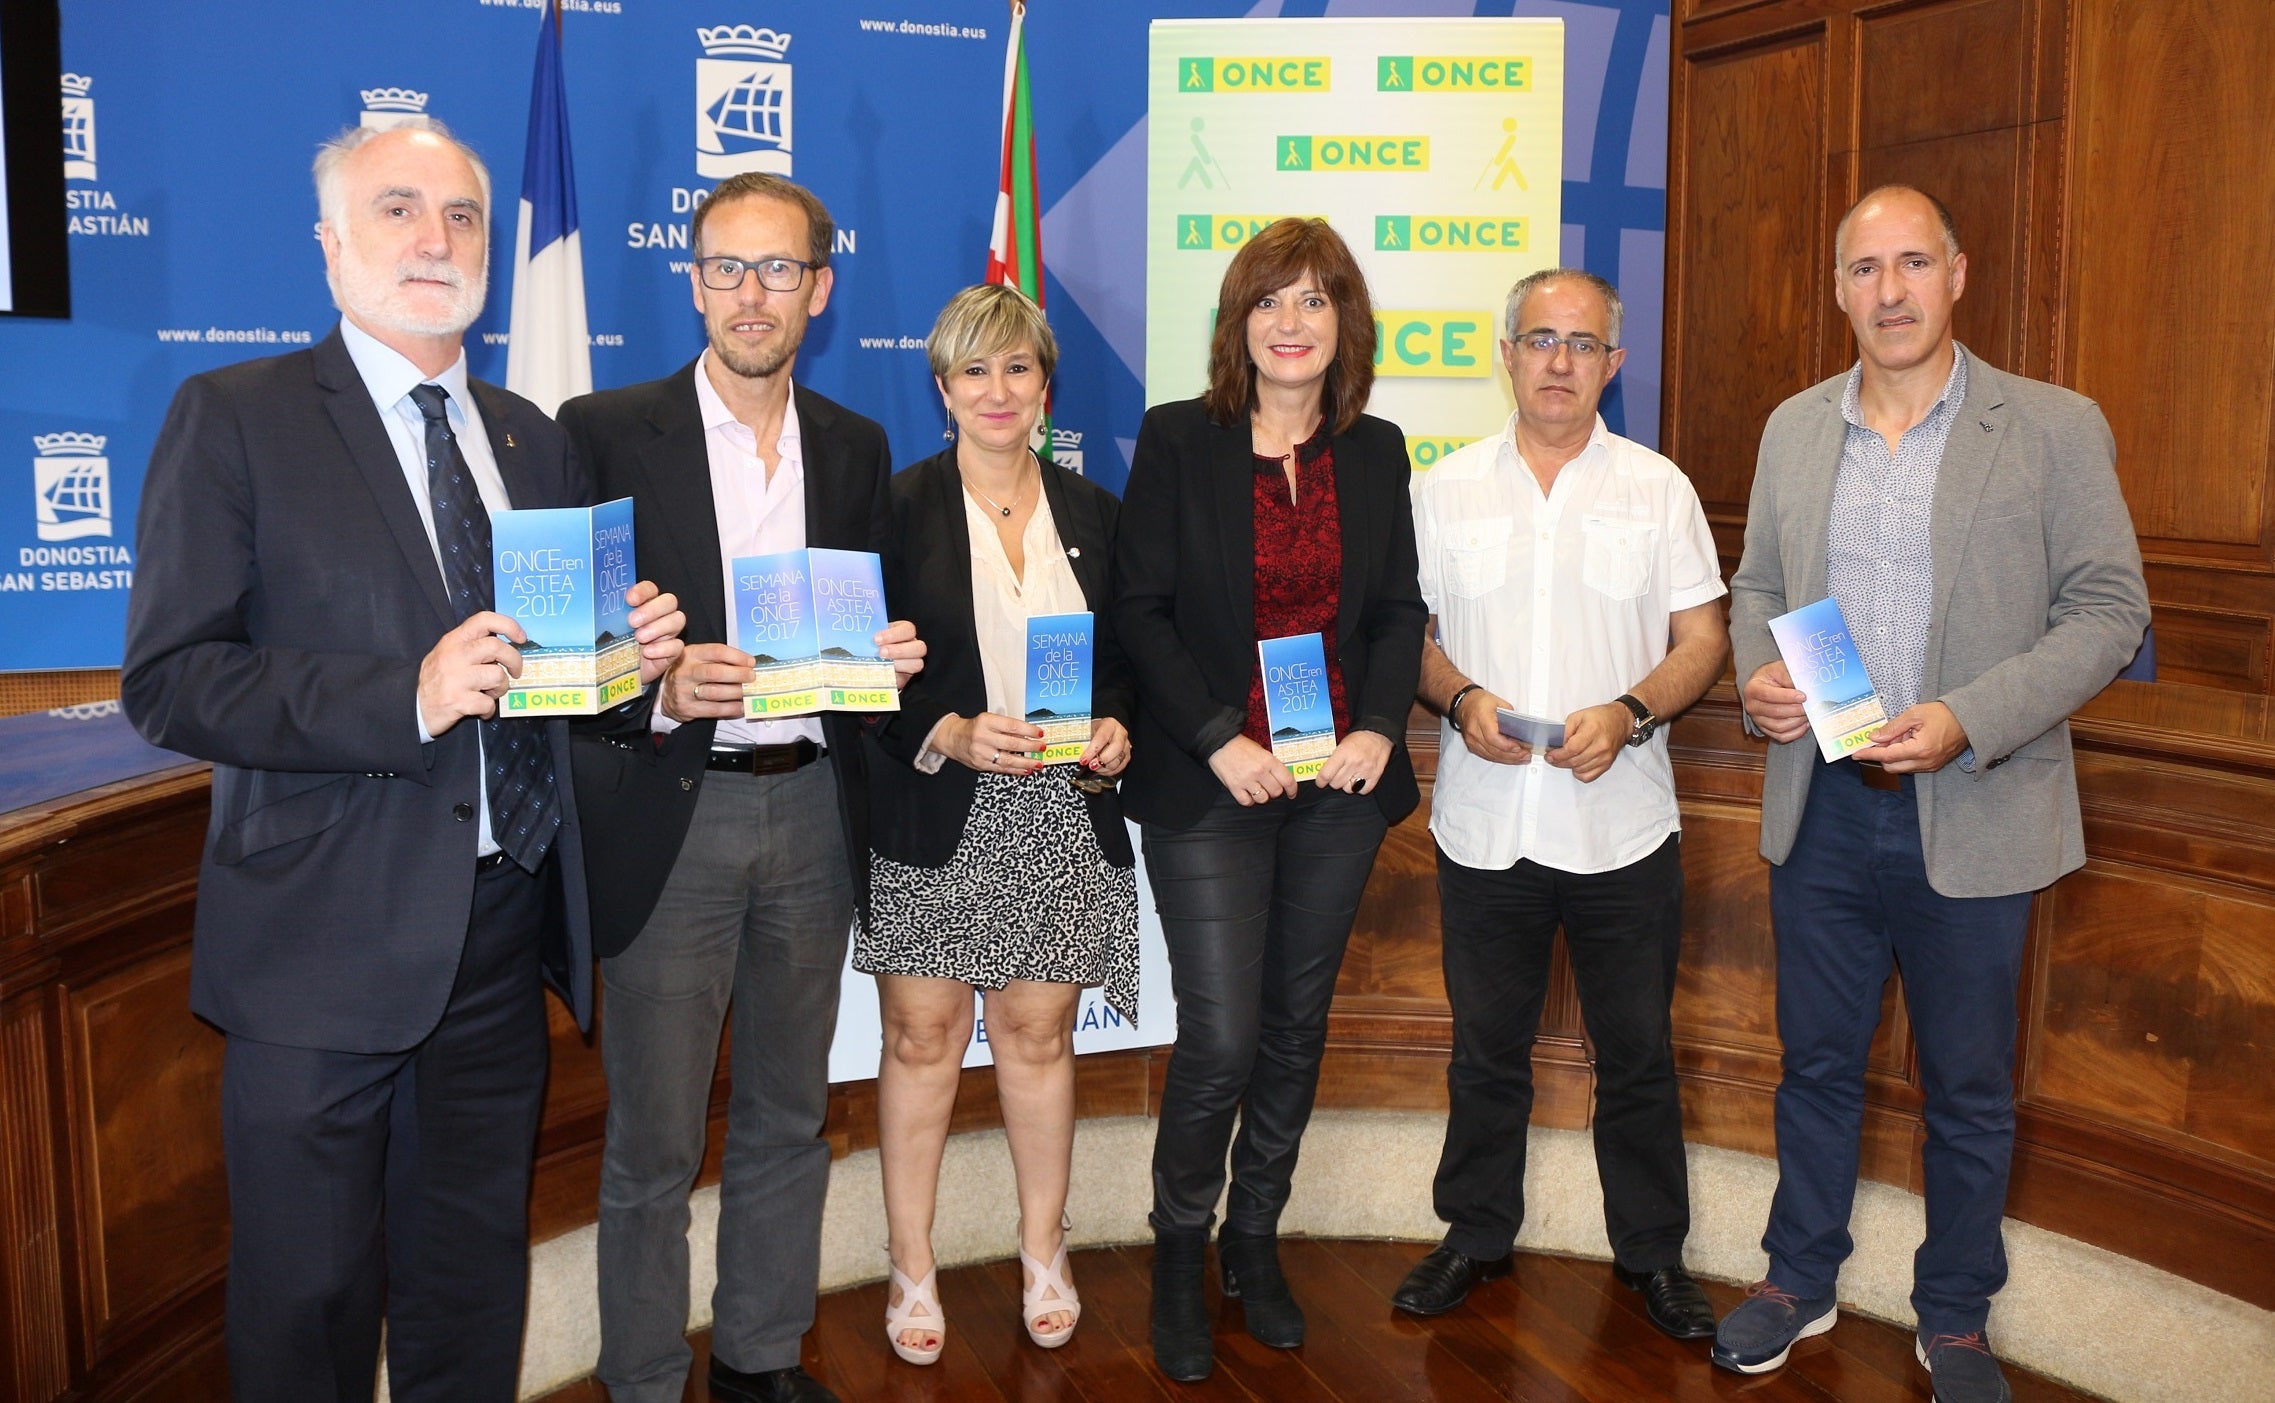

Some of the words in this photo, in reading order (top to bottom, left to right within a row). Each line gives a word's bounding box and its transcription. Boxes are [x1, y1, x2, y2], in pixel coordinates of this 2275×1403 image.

[480, 0, 622, 14] www.dostia.eus
[859, 19, 987, 39] www.donostia.eus
[1222, 62, 1322, 87] ONCE
[1421, 61, 1524, 87] ONCE
[1320, 141, 1421, 166] ONCE
[66, 190, 116, 210] STIA
[68, 213, 149, 236] ASTIÁN
[1419, 221, 1521, 246] ONCE
[627, 222, 688, 250] SAN
[157, 327, 312, 344] www.donostia.eus
[594, 523, 632, 551] SEMANA
[19, 546, 132, 567] DONOSTIA
[500, 549, 584, 574] ONCEren
[604, 551, 615, 568] de
[615, 548, 623, 565] la
[41, 570, 133, 591] SEBASTI
[512, 575, 575, 594] ASTEA
[601, 565, 627, 592] ONCE
[739, 570, 806, 592] SEMANA
[817, 577, 879, 598] ONCEren
[515, 594, 572, 618] 2017
[602, 588, 628, 616] 2017
[758, 590, 776, 605] de
[779, 588, 791, 602] la
[827, 598, 873, 614] ASTEA
[751, 602, 800, 624] ONCE
[831, 614, 872, 632] 2017
[755, 620, 800, 642] 2017
[1032, 632, 1087, 650] SEMANA
[1045, 649, 1061, 664] de
[1063, 647, 1073, 662] la
[1037, 662, 1080, 680] ONCE
[1269, 662, 1323, 683] ONCEren
[1808, 659, 1846, 687] 2017
[610, 678, 635, 698] ONCE
[1039, 679, 1078, 698] 2017
[1278, 680, 1318, 697] ASTEA
[531, 693, 582, 706] ONCE
[771, 695, 812, 709] ONCE
[847, 693, 888, 704] ONCE
[1281, 693, 1317, 713] 2017
[1046, 746, 1081, 758] ONCE
[1296, 763, 1322, 775] ONC
